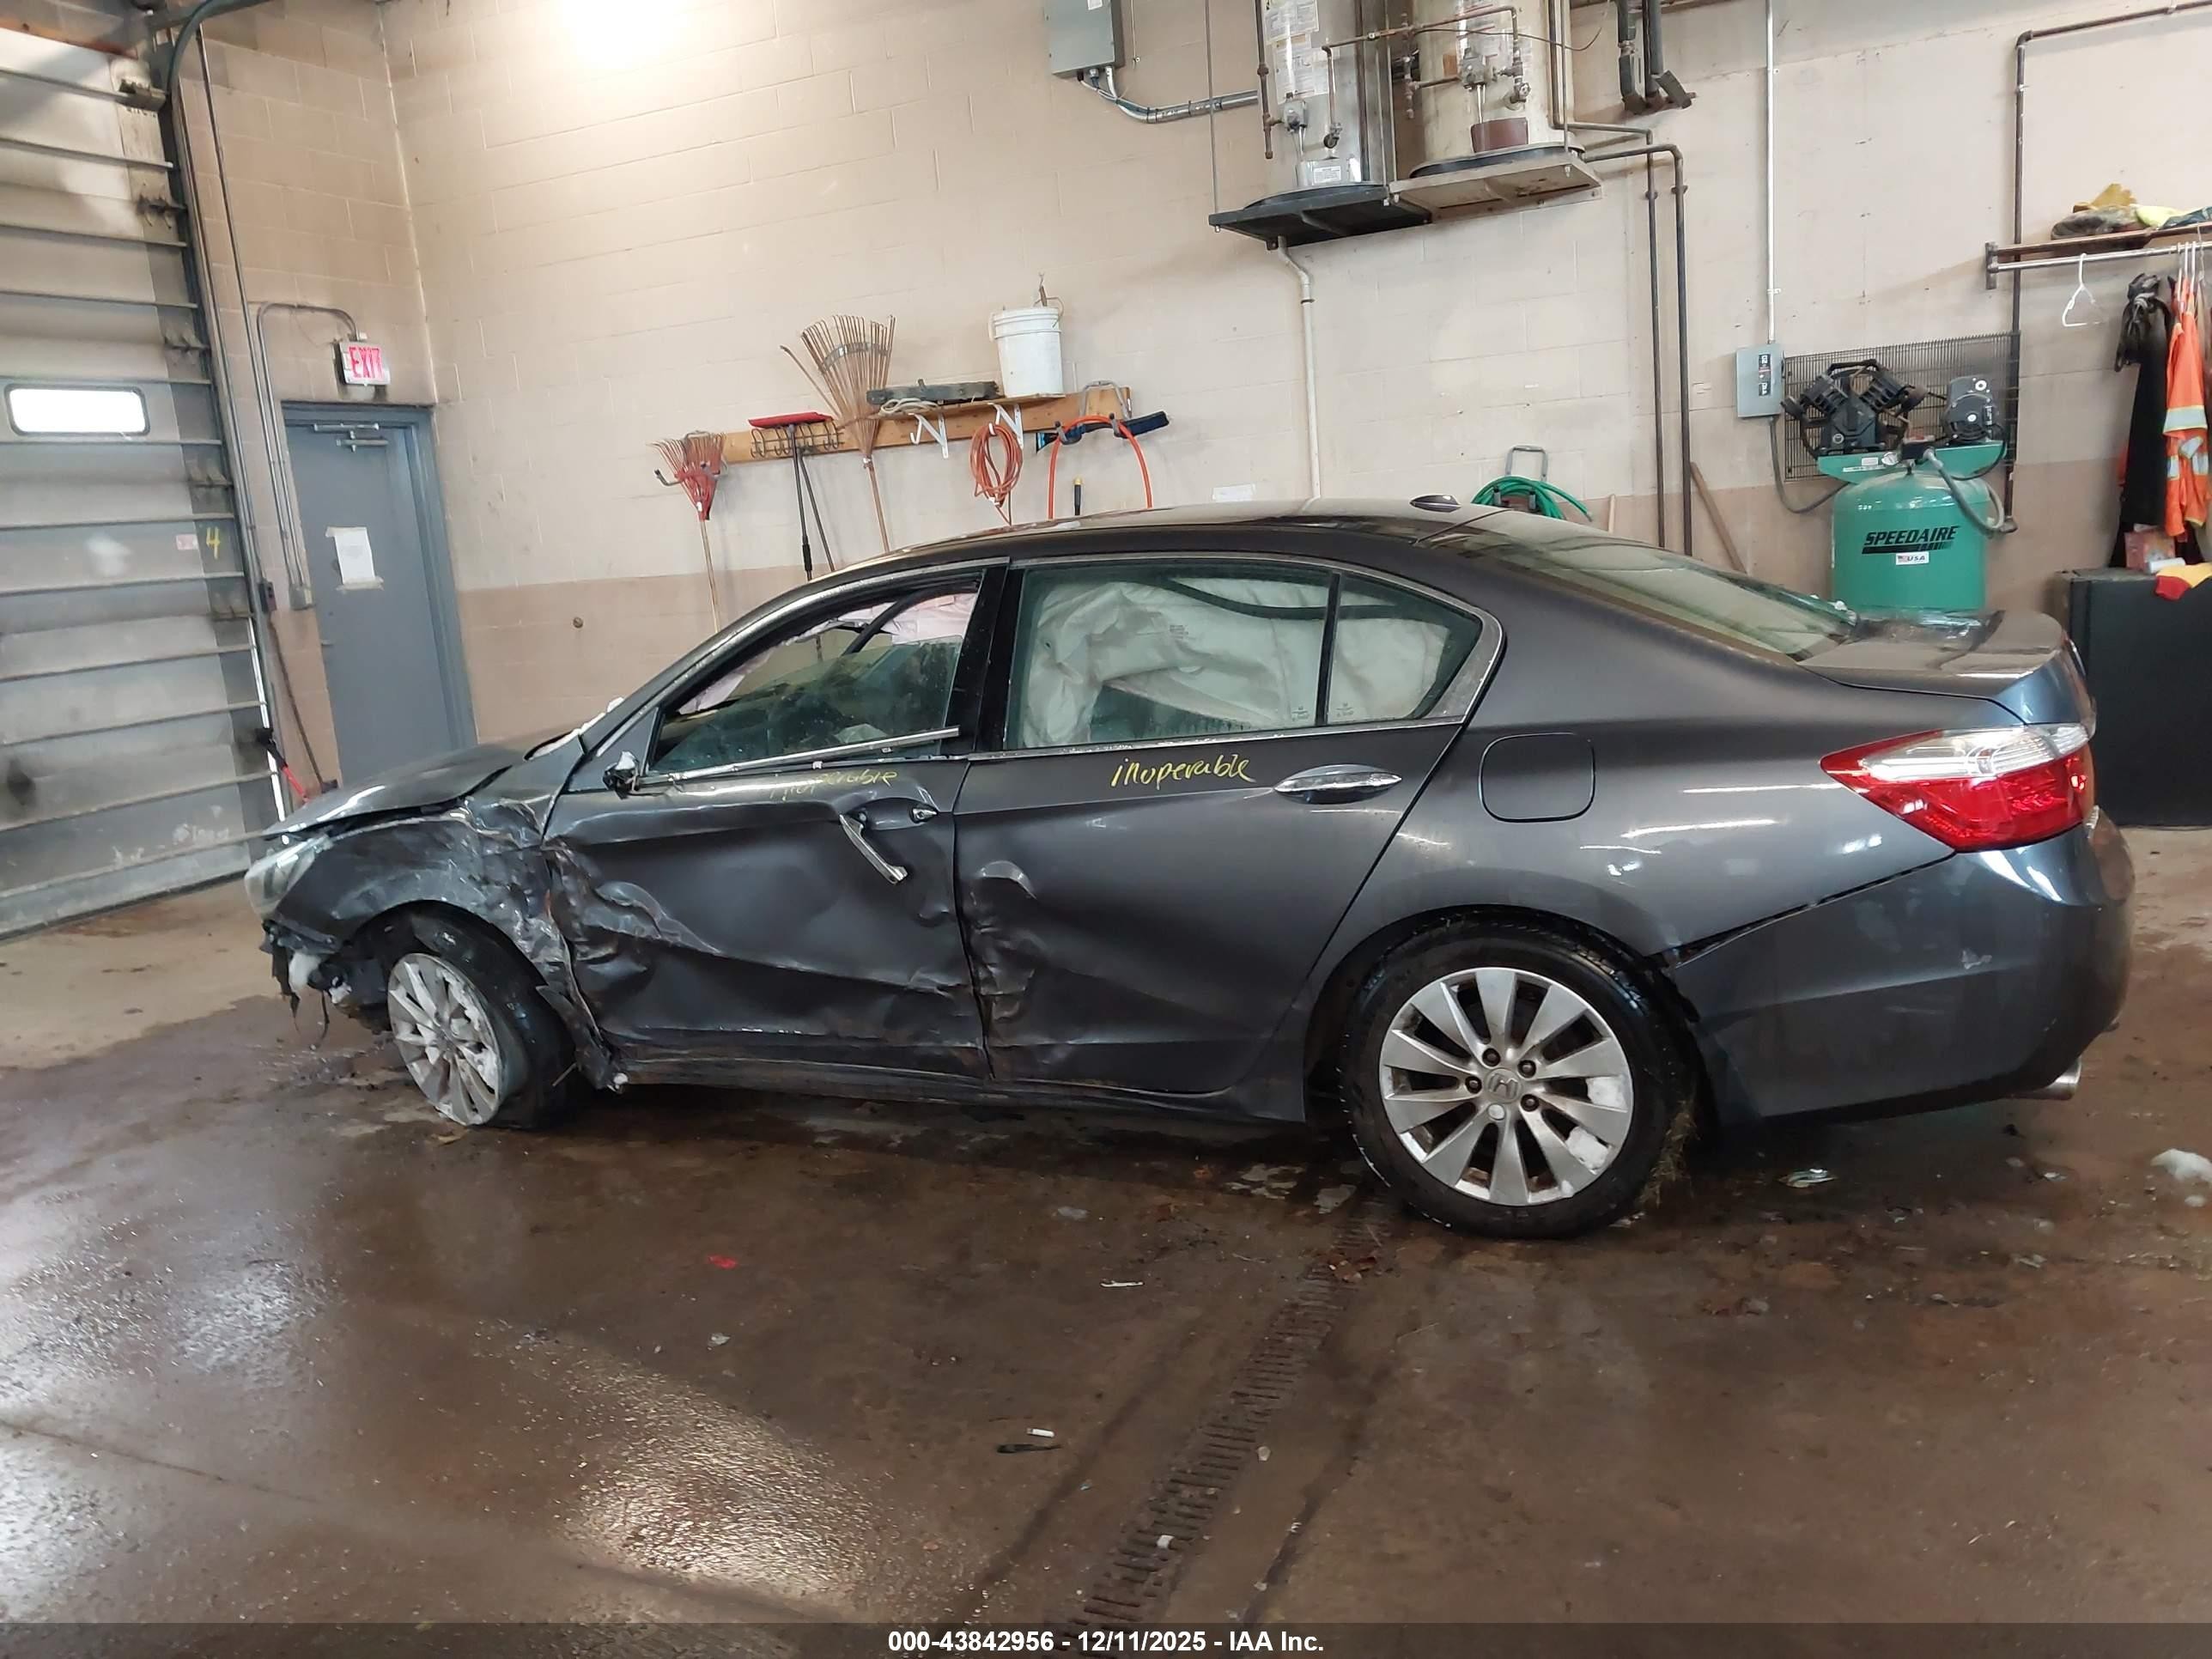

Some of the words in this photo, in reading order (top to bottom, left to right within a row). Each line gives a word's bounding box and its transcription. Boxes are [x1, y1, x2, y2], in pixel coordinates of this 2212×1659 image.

[348, 346, 384, 378] EXIT
[206, 526, 221, 559] 4
[1863, 525, 1961, 546] SPEEDAIRE
[1110, 754, 1257, 791] inoperable
